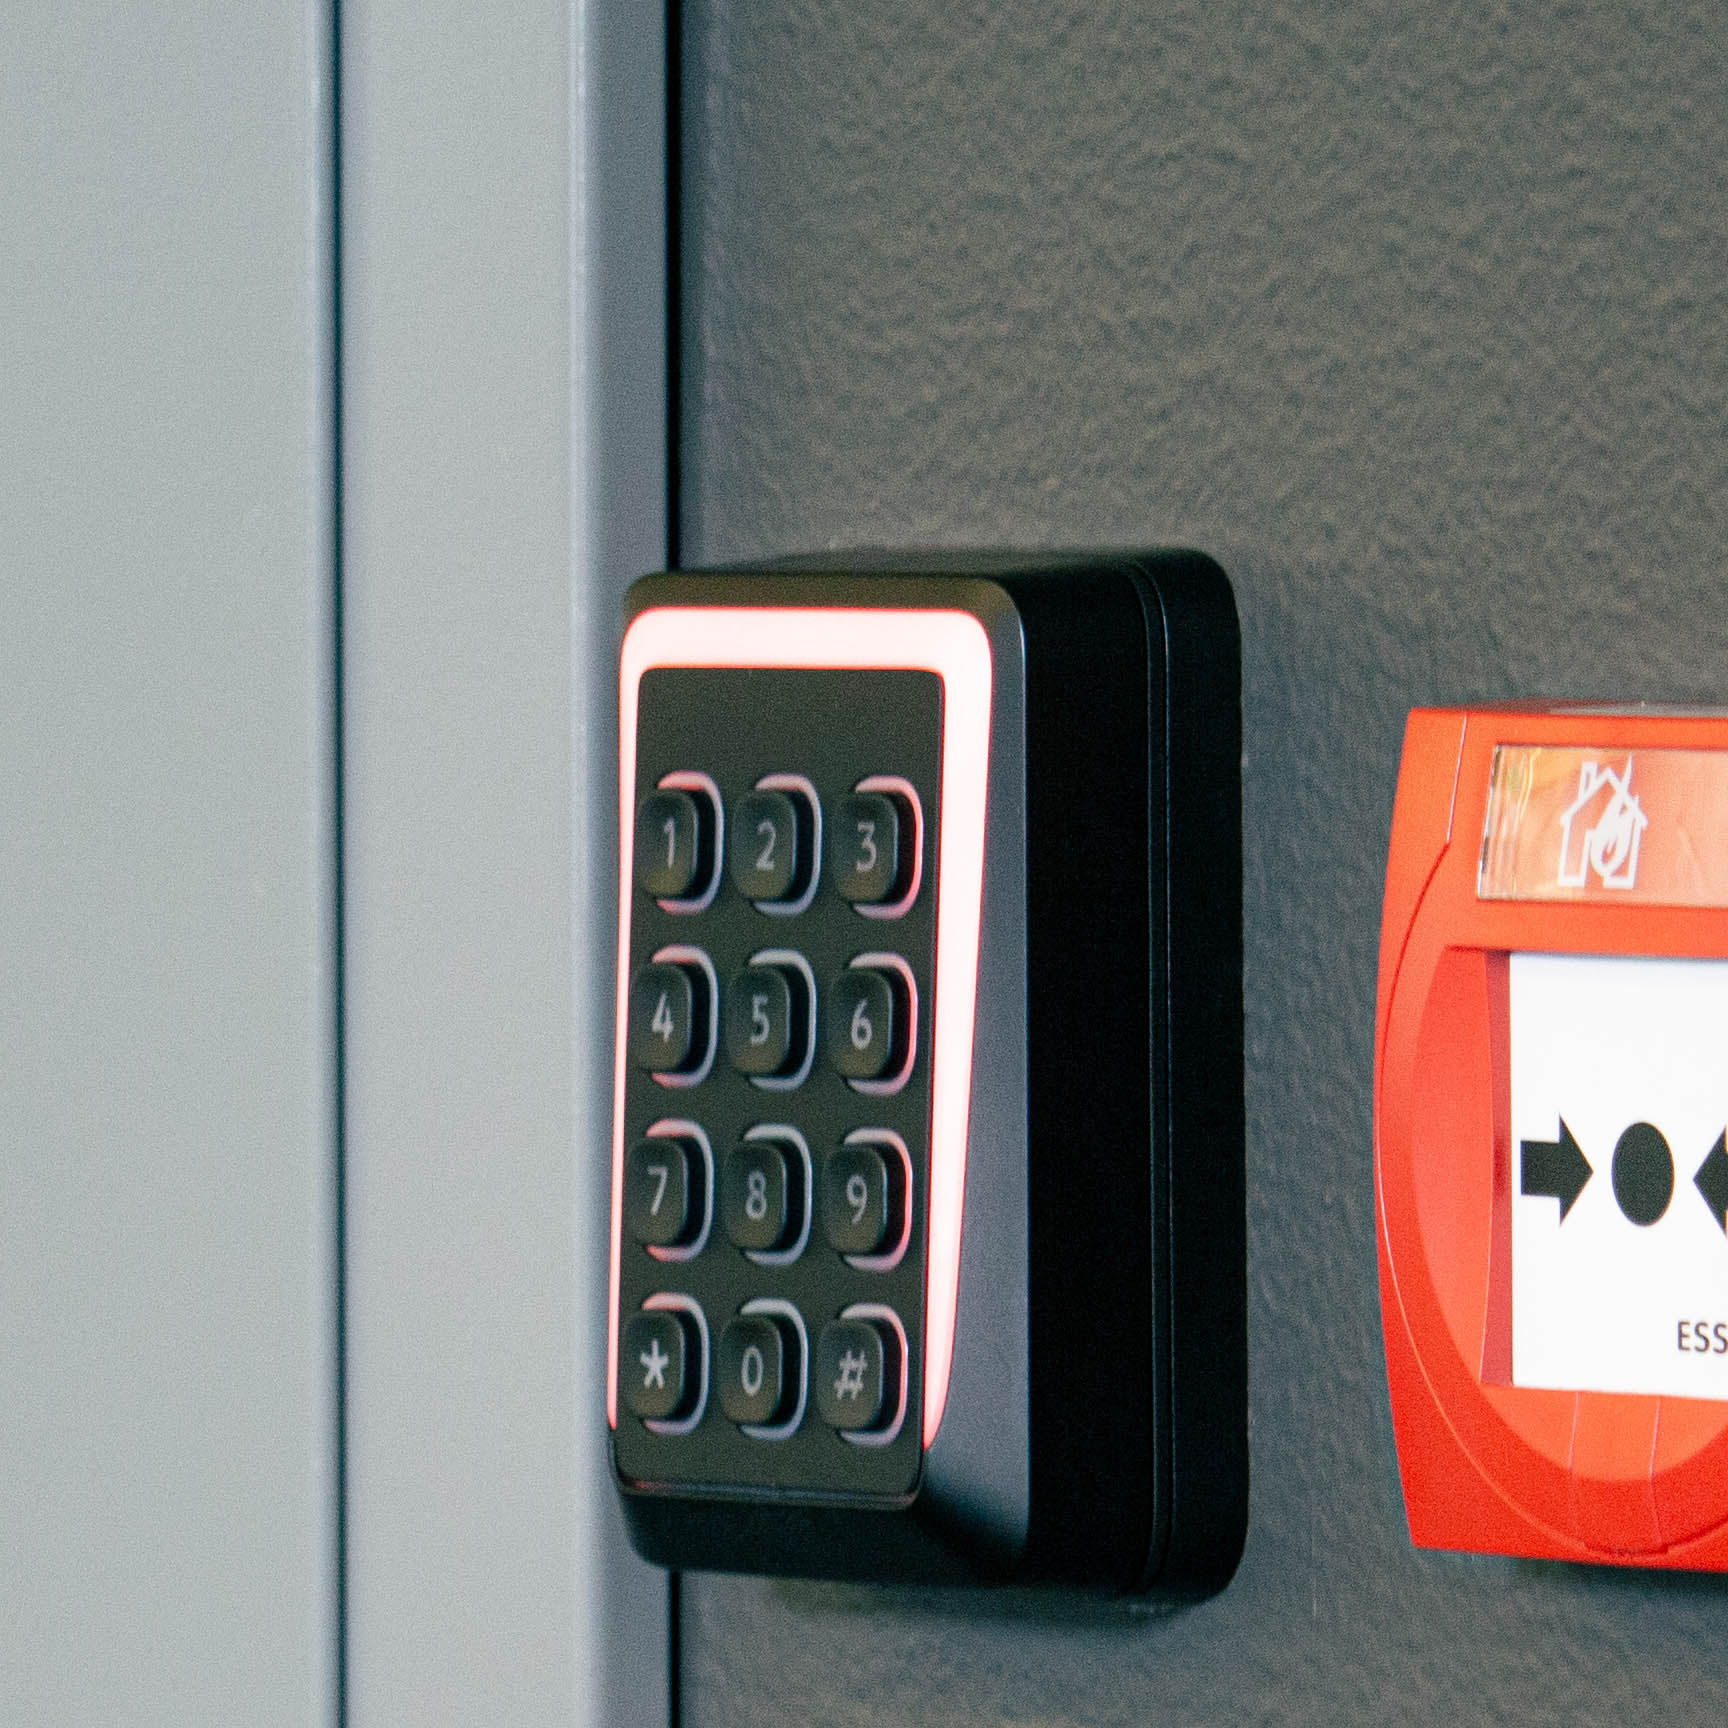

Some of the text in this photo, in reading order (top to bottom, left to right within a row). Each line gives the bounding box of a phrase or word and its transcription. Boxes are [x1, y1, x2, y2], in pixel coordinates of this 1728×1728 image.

[663, 818, 878, 874] 1 2 3
[650, 992, 873, 1051] 4 5 6
[647, 1165, 868, 1226] 7 8 9
[740, 1346, 764, 1398] 0
